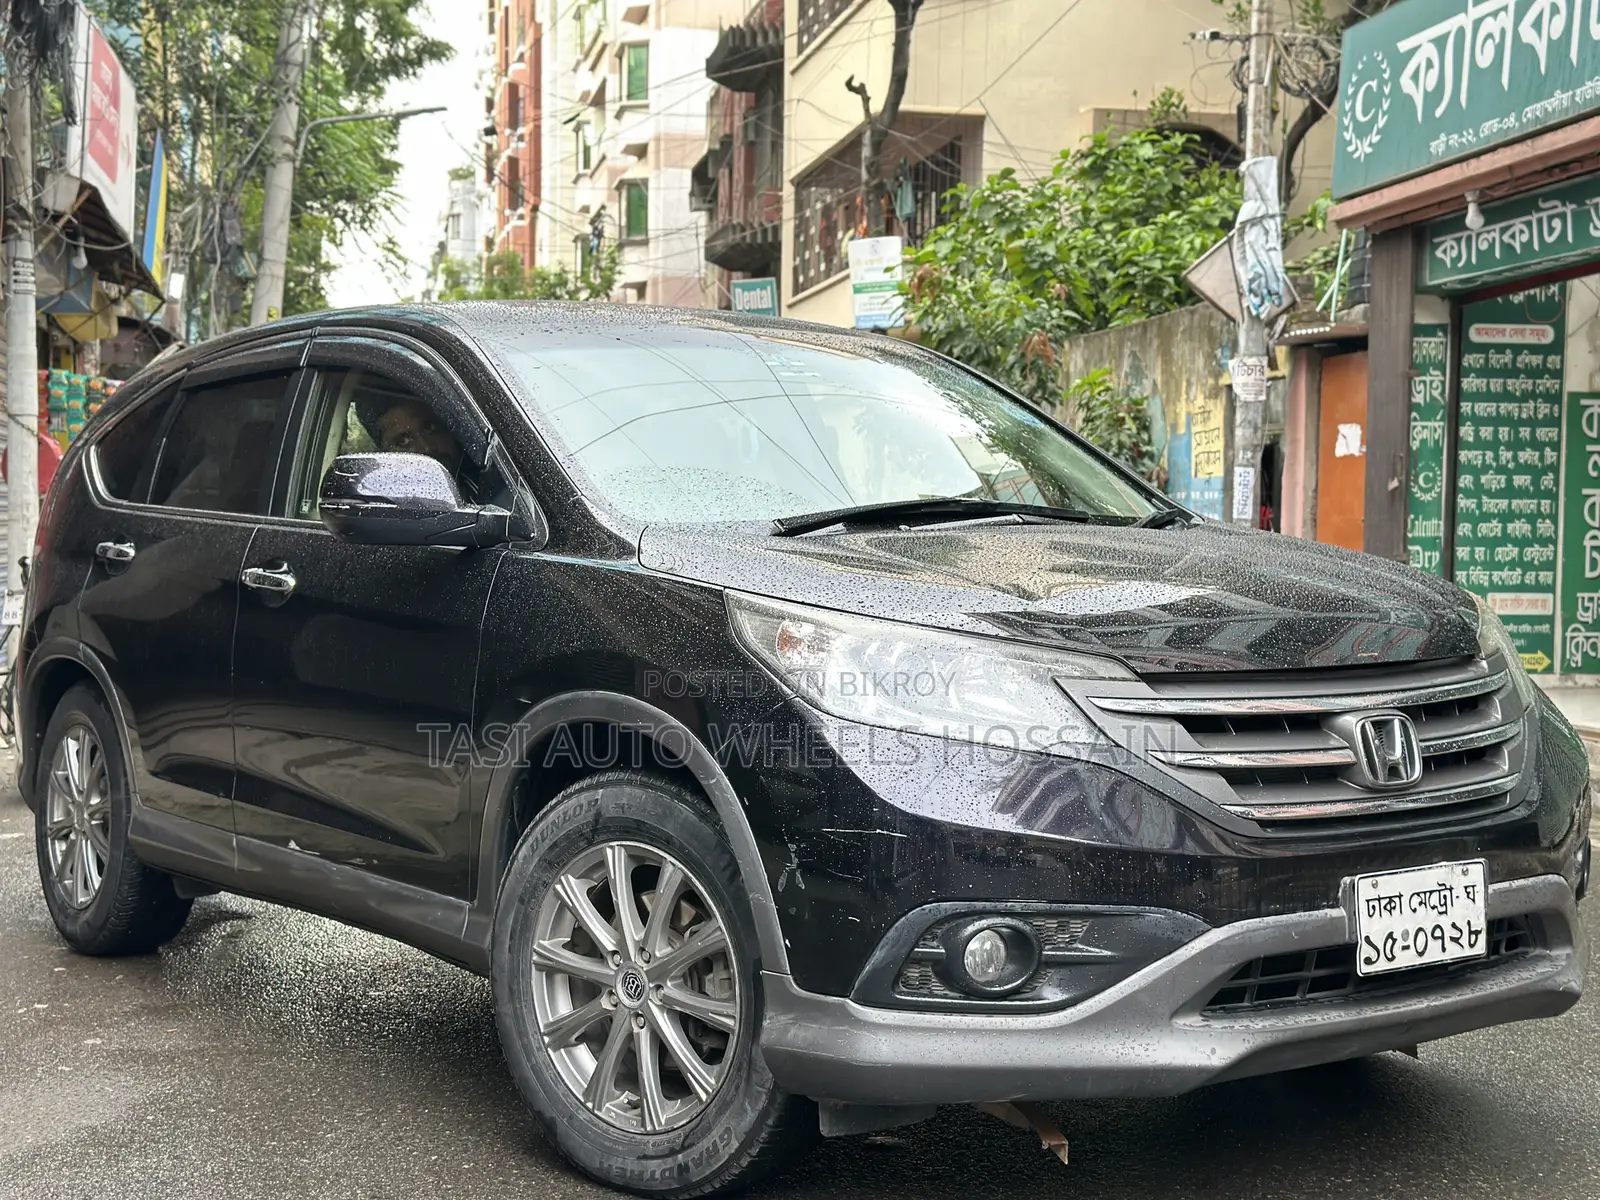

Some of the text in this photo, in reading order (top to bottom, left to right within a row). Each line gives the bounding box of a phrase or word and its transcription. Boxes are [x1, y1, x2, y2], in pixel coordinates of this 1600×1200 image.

[1397, 0, 1600, 124] ক্যালকা
[1432, 198, 1577, 269] ক্যালকাটা
[735, 285, 772, 310] Dental
[1411, 367, 1445, 407] ড্রাই
[1409, 410, 1445, 451] ক্লিনার্স
[1406, 514, 1444, 538] Calcutta
[1407, 545, 1440, 573] Dry
[530, 797, 600, 853] DUNLOP
[1365, 892, 1403, 918] ঢাকা
[1363, 919, 1483, 966] ১৫-০৭২৮
